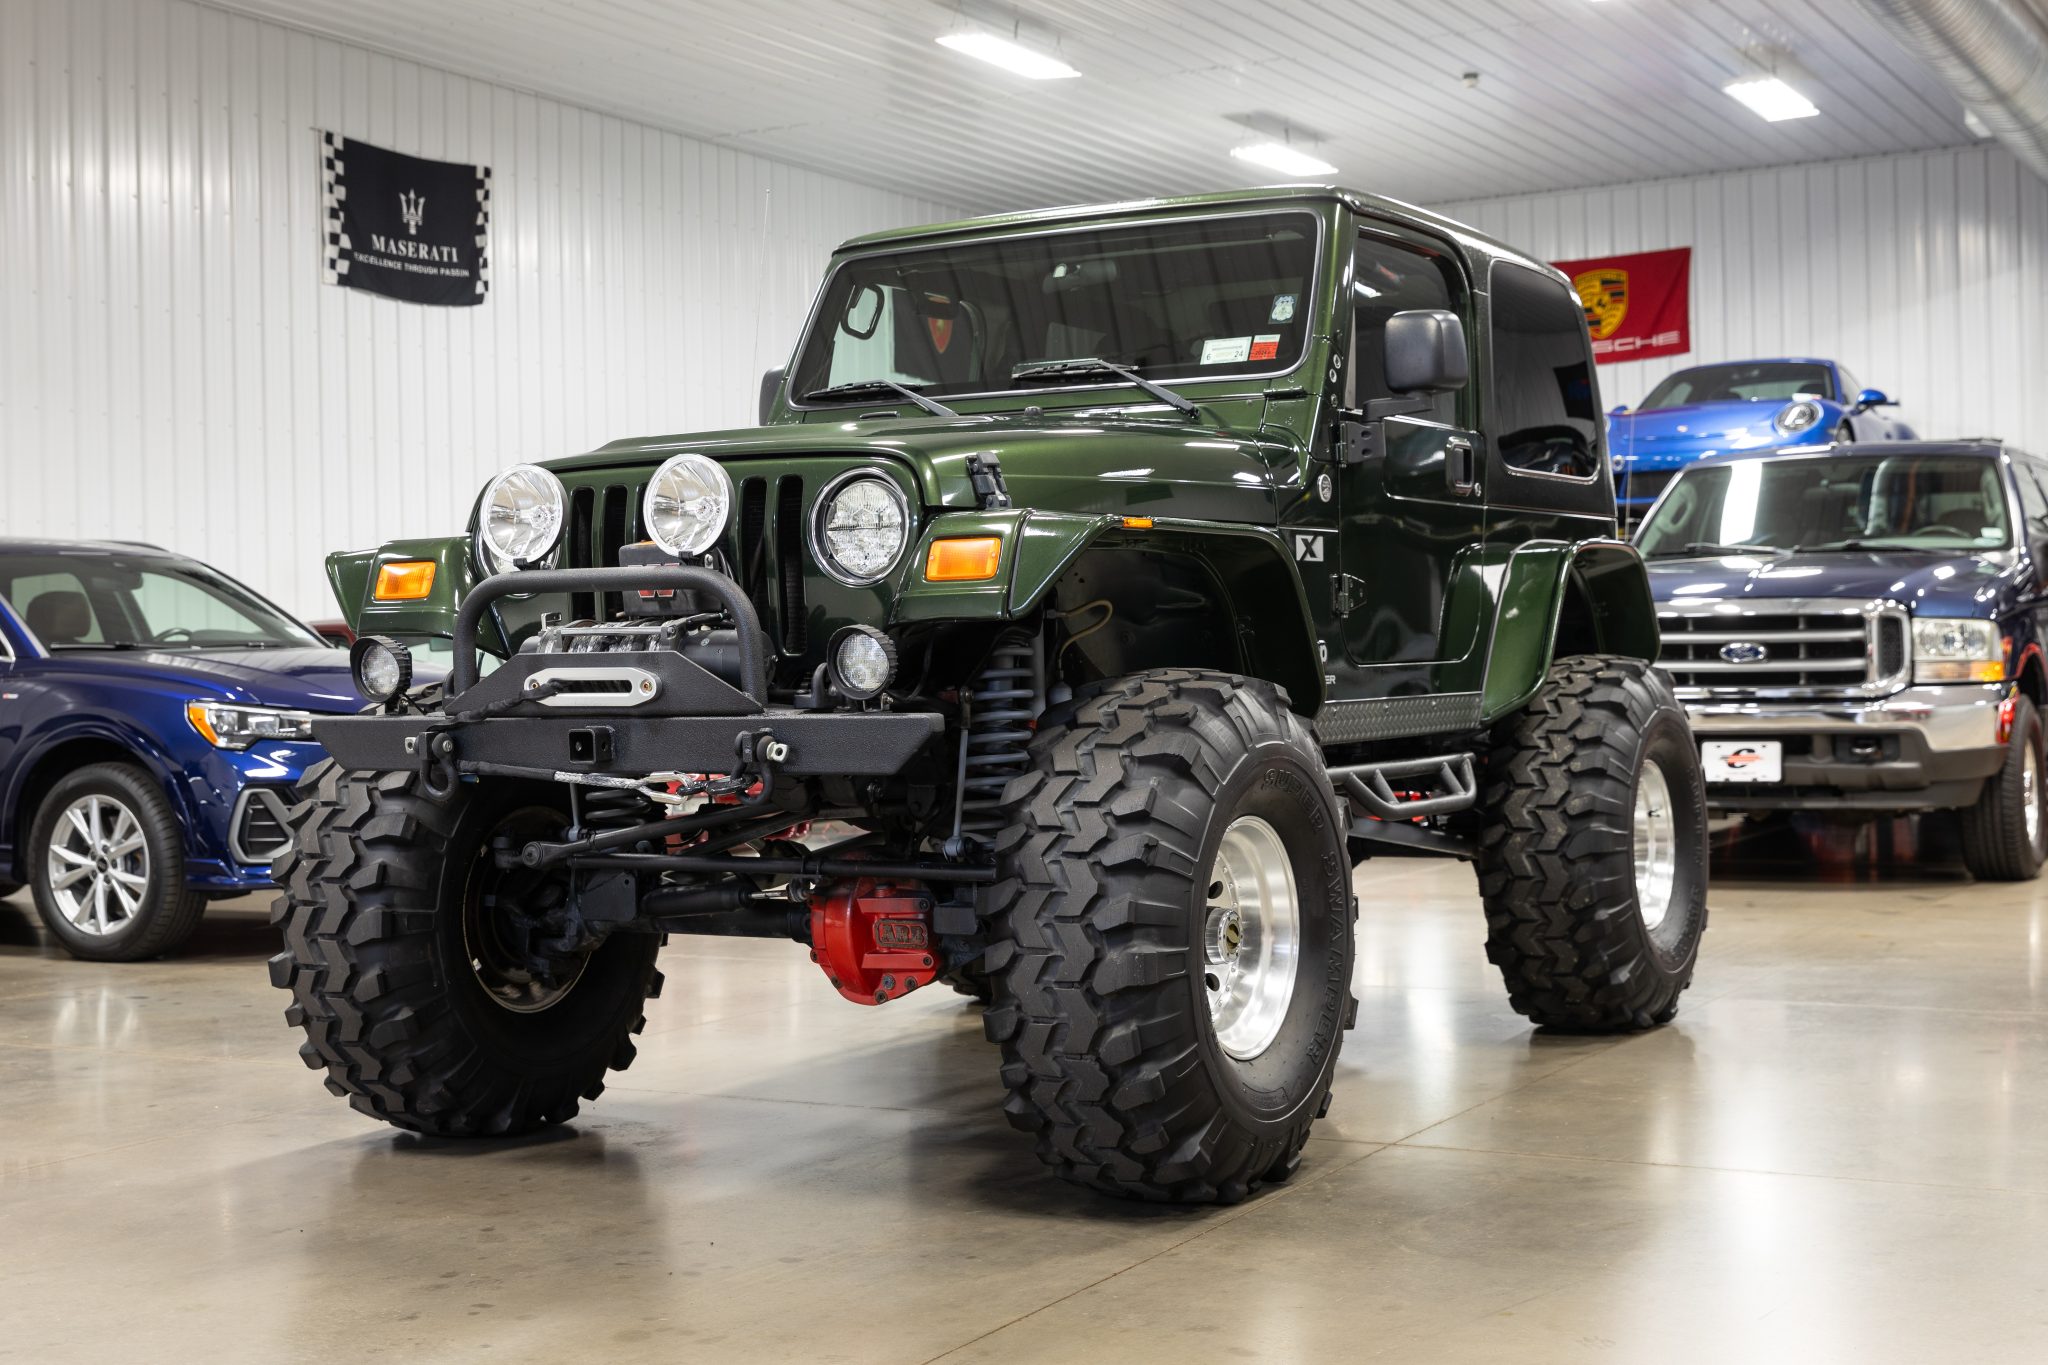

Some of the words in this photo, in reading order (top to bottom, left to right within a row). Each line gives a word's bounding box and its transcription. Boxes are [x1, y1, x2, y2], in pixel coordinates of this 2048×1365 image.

[371, 233, 458, 263] MASERATI
[404, 262, 438, 275] THROUGH
[1591, 330, 1680, 354] SCHE
[1298, 535, 1320, 561] X
[1262, 768, 1325, 834] SUPER
[881, 924, 926, 943] ARB
[1306, 850, 1345, 1066] SWAMPER
